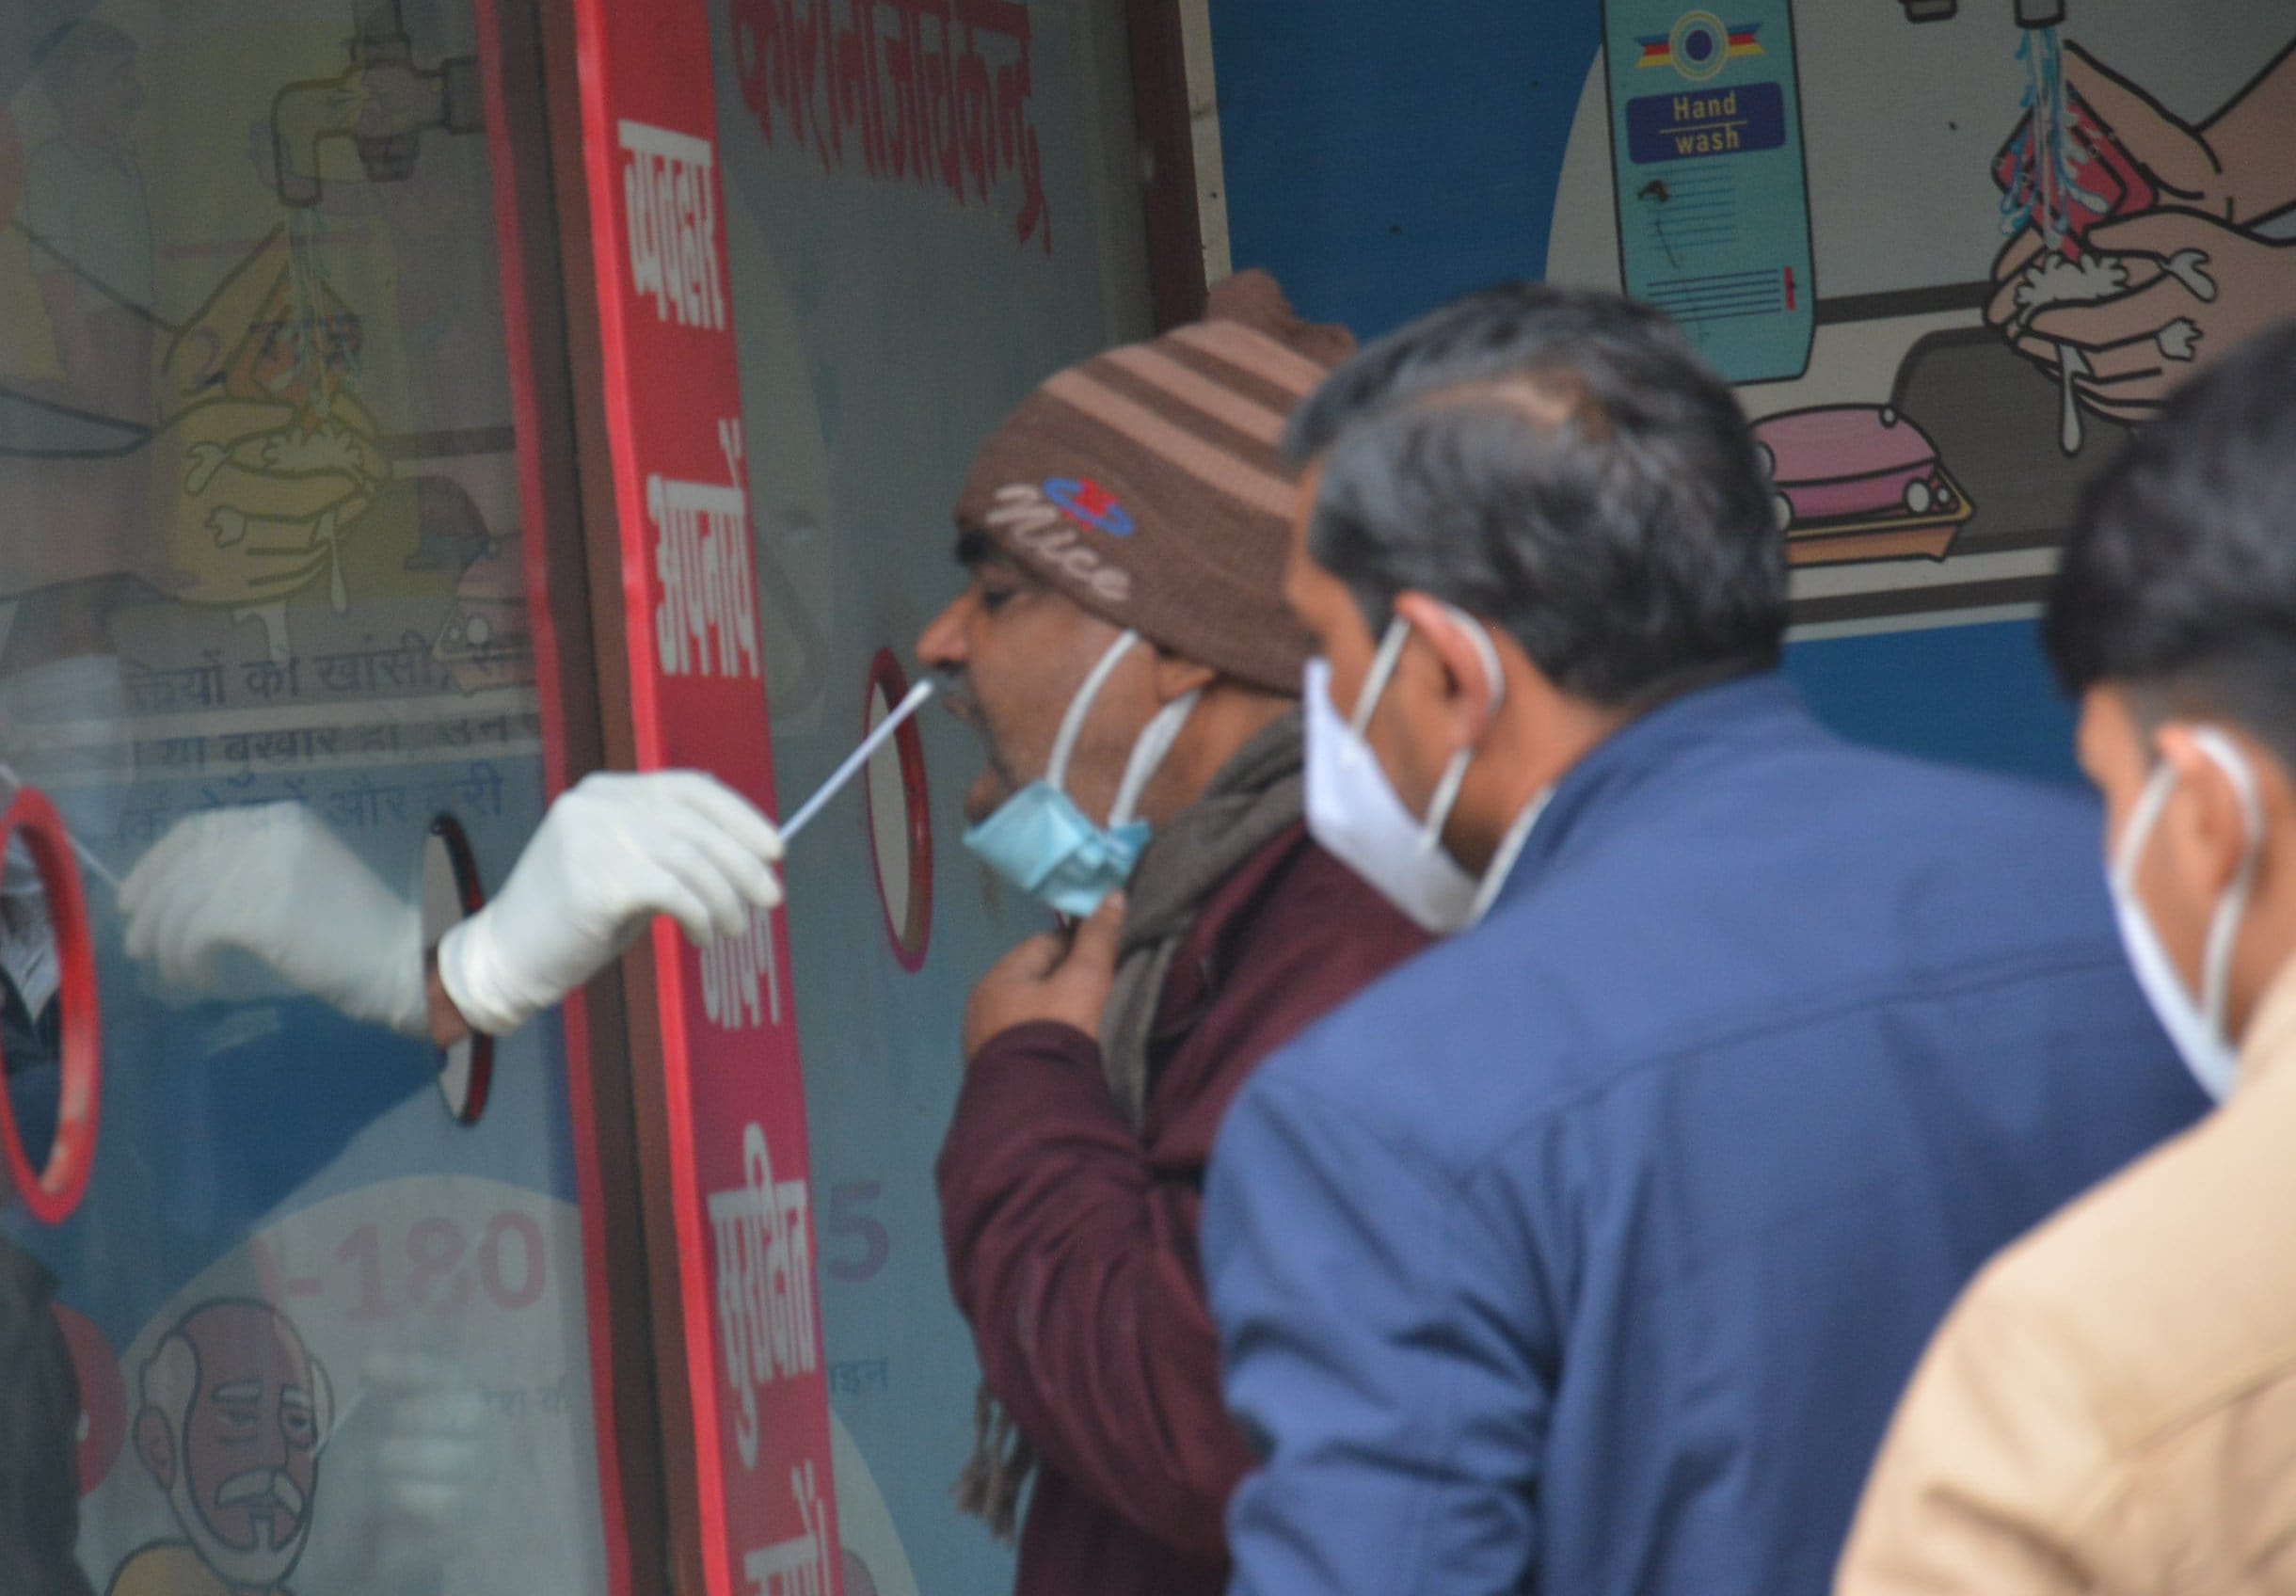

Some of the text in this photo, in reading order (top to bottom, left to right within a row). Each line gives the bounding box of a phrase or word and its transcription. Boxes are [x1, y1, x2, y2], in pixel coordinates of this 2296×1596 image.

[1673, 90, 1737, 121] Hand
[1675, 126, 1740, 155] wash
[986, 483, 1131, 602] Nice
[708, 1122, 817, 1470] सुरक्षित
